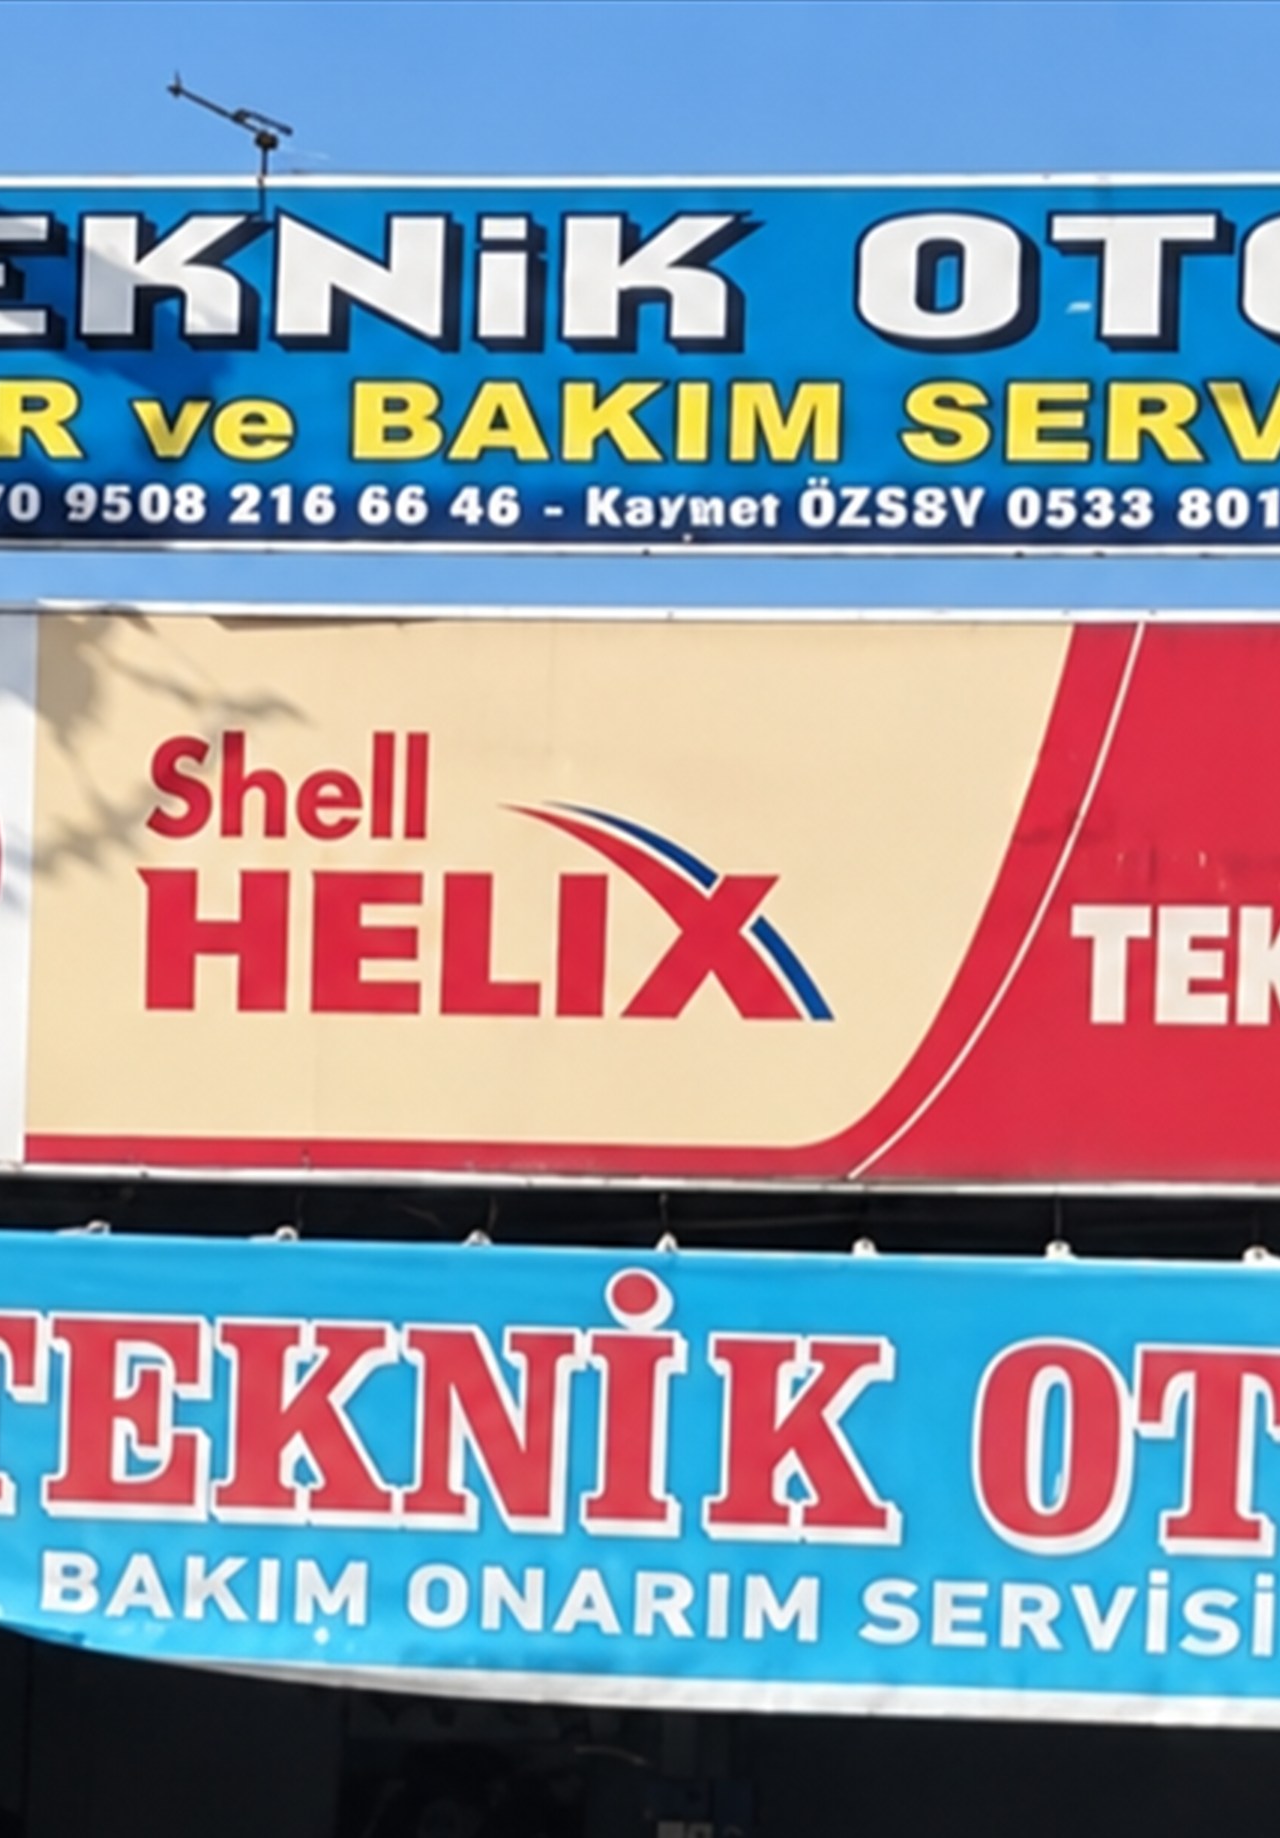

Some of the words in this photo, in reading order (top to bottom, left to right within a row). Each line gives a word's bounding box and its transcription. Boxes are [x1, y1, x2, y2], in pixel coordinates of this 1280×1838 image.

[132, 399, 293, 460] ve
[351, 381, 841, 462] BAKIM
[64, 483, 207, 524] 9508
[228, 483, 337, 525] 216
[357, 485, 429, 526] 66
[449, 485, 521, 527] 46
[1006, 486, 1155, 529] 0533
[144, 728, 432, 843] Shell
[136, 805, 820, 1023] HELIX
[40, 1549, 369, 1627] BAKIM
[406, 1563, 819, 1642] ONARIM
[858, 1570, 1276, 1657] SERVİSİ
